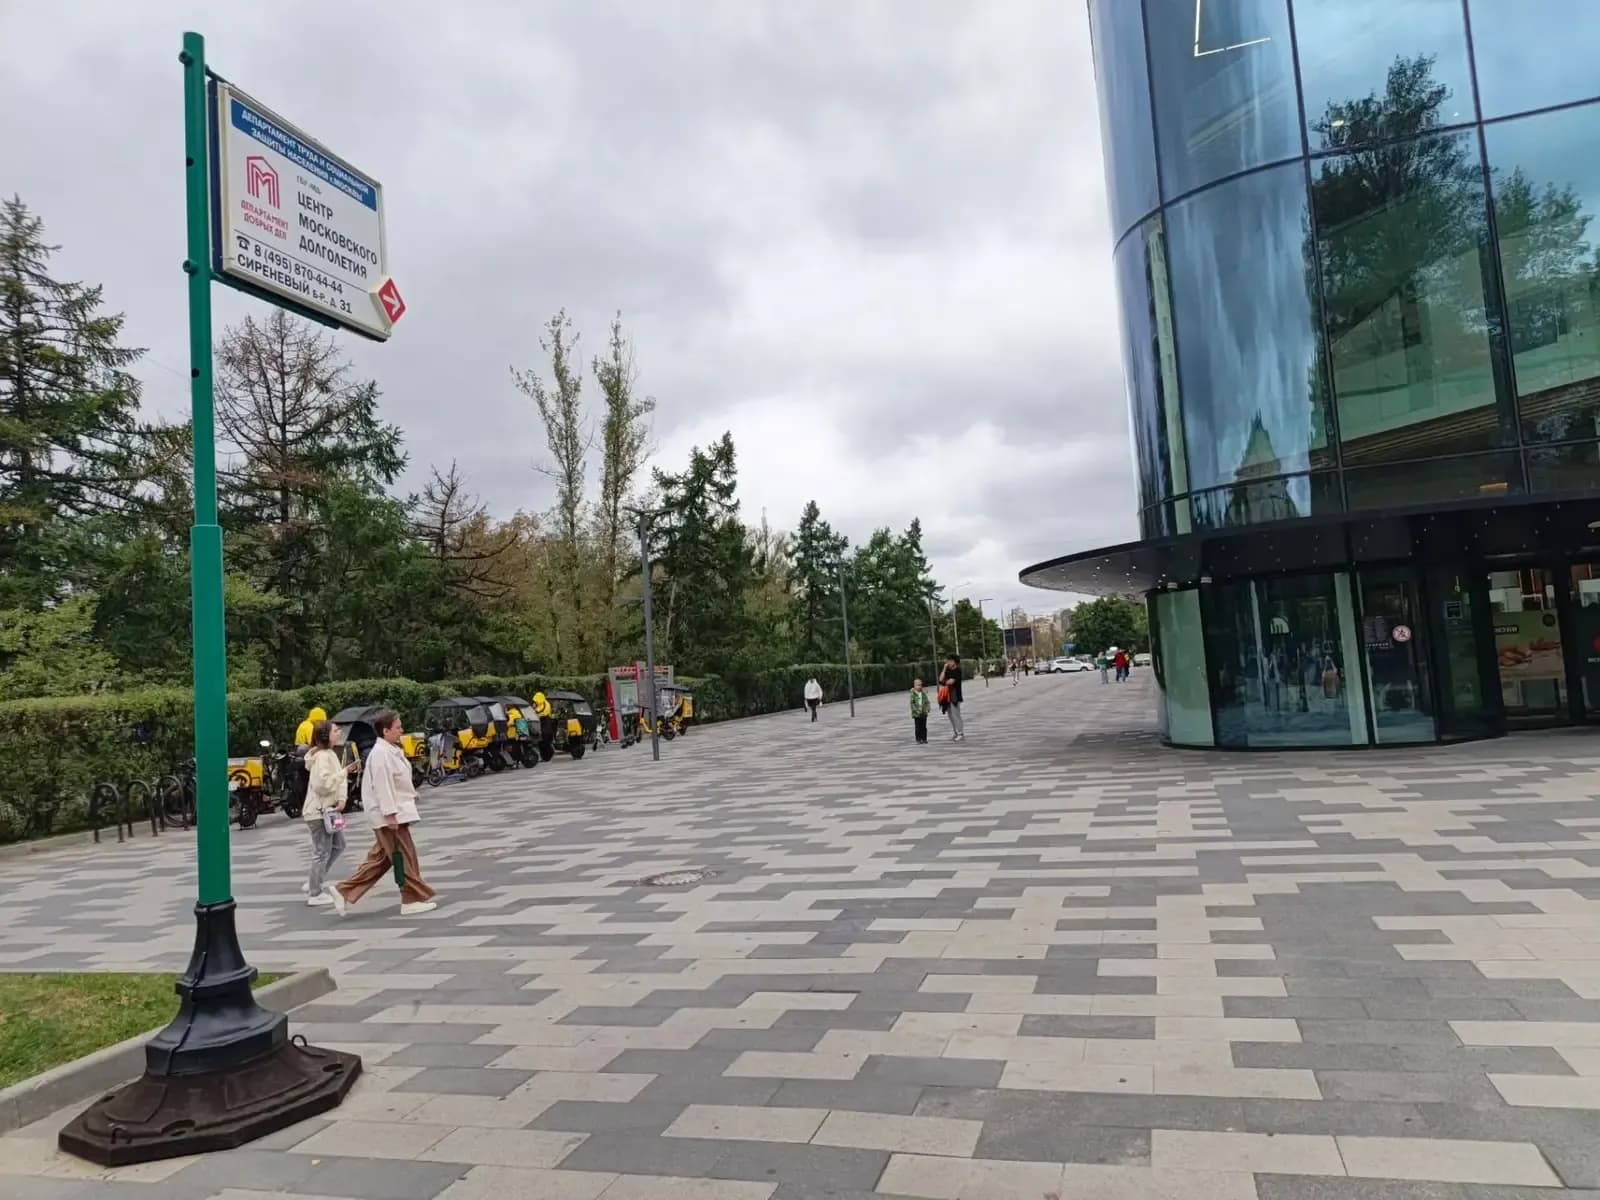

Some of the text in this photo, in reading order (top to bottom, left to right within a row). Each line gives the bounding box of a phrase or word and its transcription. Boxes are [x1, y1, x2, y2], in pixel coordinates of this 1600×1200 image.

[241, 199, 289, 231] ДЕПАРТАМЕНТ
[297, 191, 334, 221] ЦЕНТР
[298, 212, 378, 265] МОСКОВСКОГО
[299, 235, 368, 279] ДОЛГОЛЕТИЯ
[237, 253, 310, 295] СИРЕНЕВЫЙ
[340, 299, 352, 314] 31
[253, 244, 343, 294] 8 (495) 870-44-44
